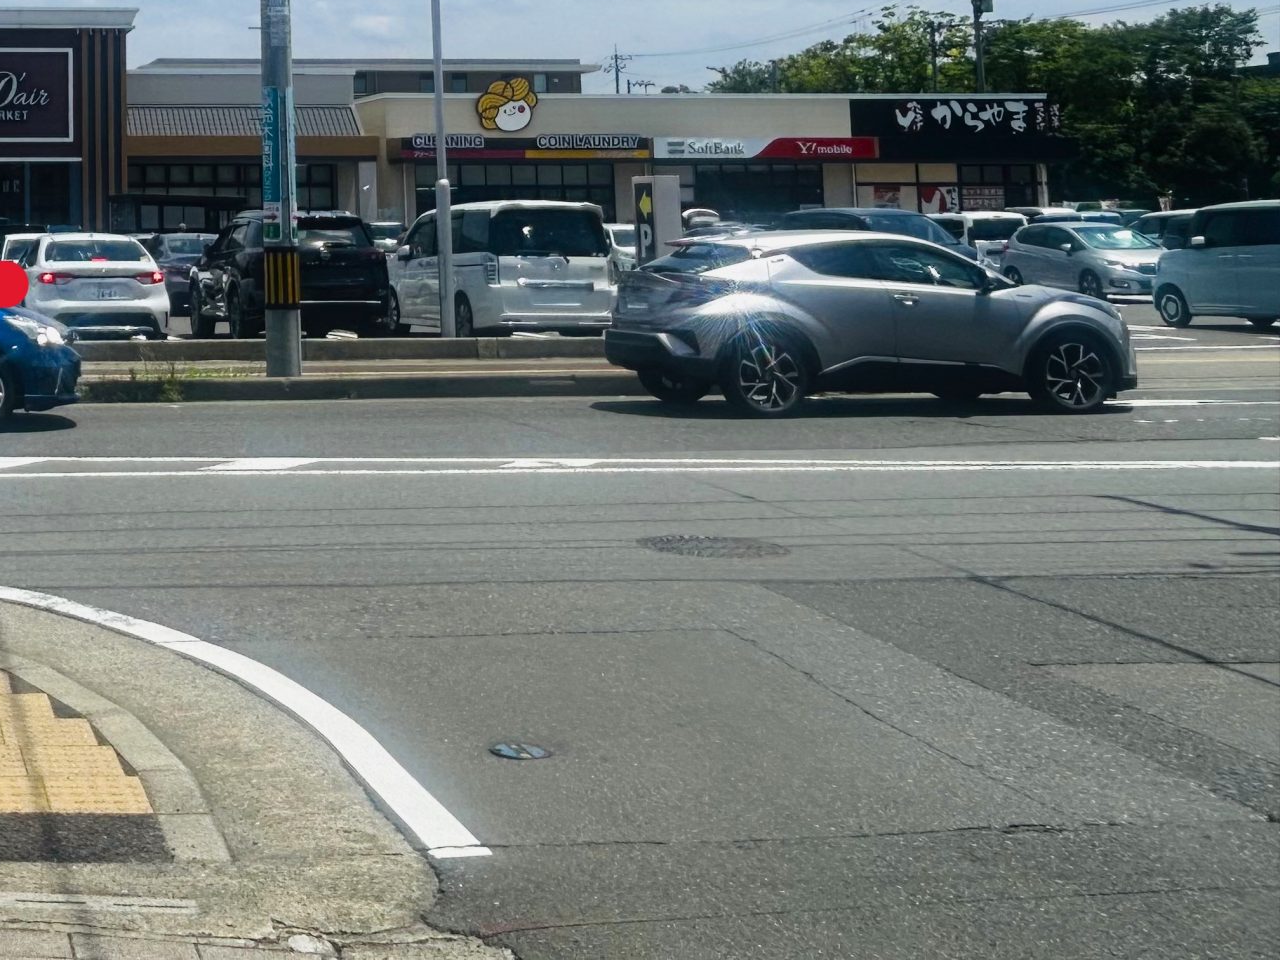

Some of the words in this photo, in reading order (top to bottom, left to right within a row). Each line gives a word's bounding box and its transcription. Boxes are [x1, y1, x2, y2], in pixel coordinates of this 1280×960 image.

[931, 100, 1029, 133] からやま
[538, 135, 572, 148] COIN
[574, 135, 638, 148] LAUNDRY
[687, 141, 745, 155] SoftBank
[640, 224, 653, 257] P
